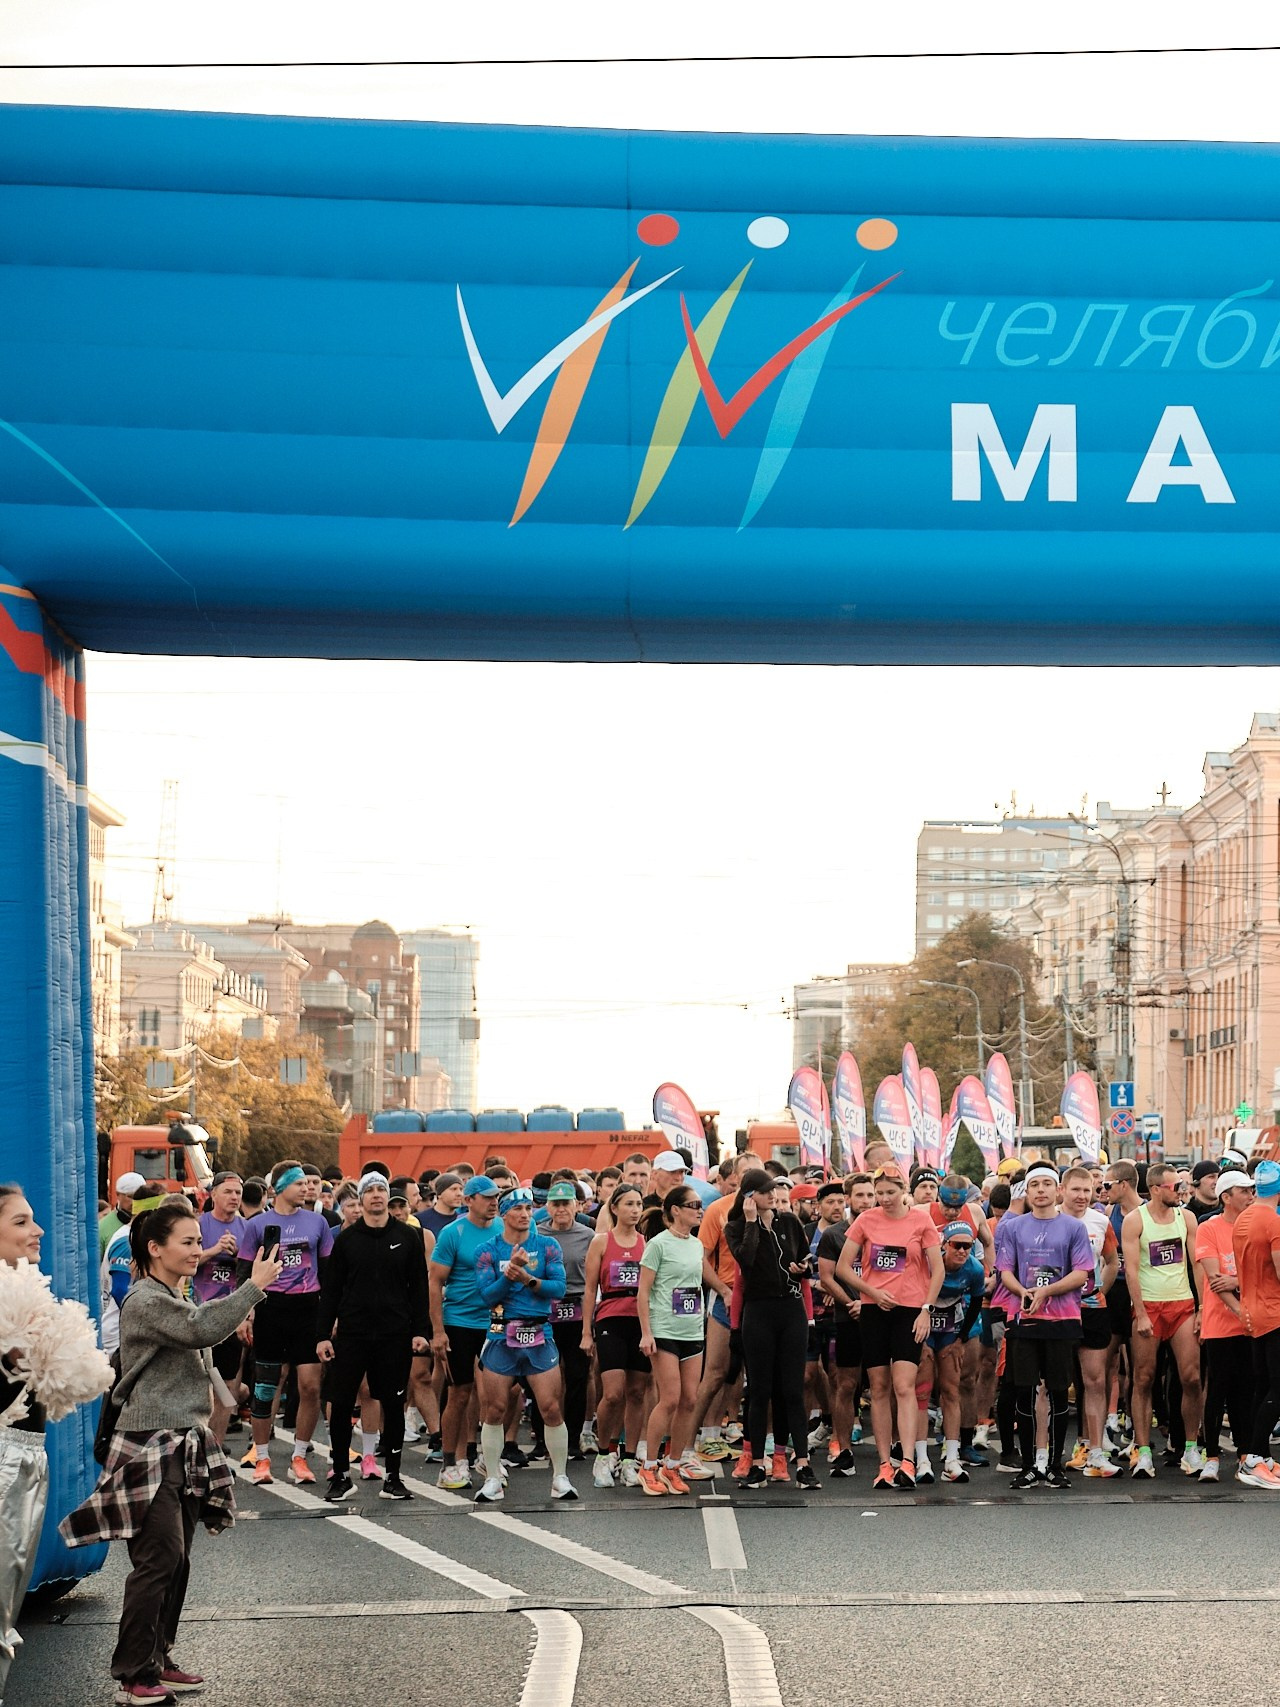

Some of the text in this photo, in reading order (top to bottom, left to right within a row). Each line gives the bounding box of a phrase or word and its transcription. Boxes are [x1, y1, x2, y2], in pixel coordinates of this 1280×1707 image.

[1160, 1249, 1174, 1261] 151
[283, 1255, 302, 1267] 328
[877, 1256, 896, 1268] 695
[212, 1270, 230, 1282] 242
[618, 1272, 638, 1283] 323
[1036, 1277, 1049, 1288] 83
[683, 1299, 695, 1310] 80
[557, 1308, 574, 1318] 333
[931, 1317, 946, 1328] 137
[516, 1332, 535, 1344] 488
